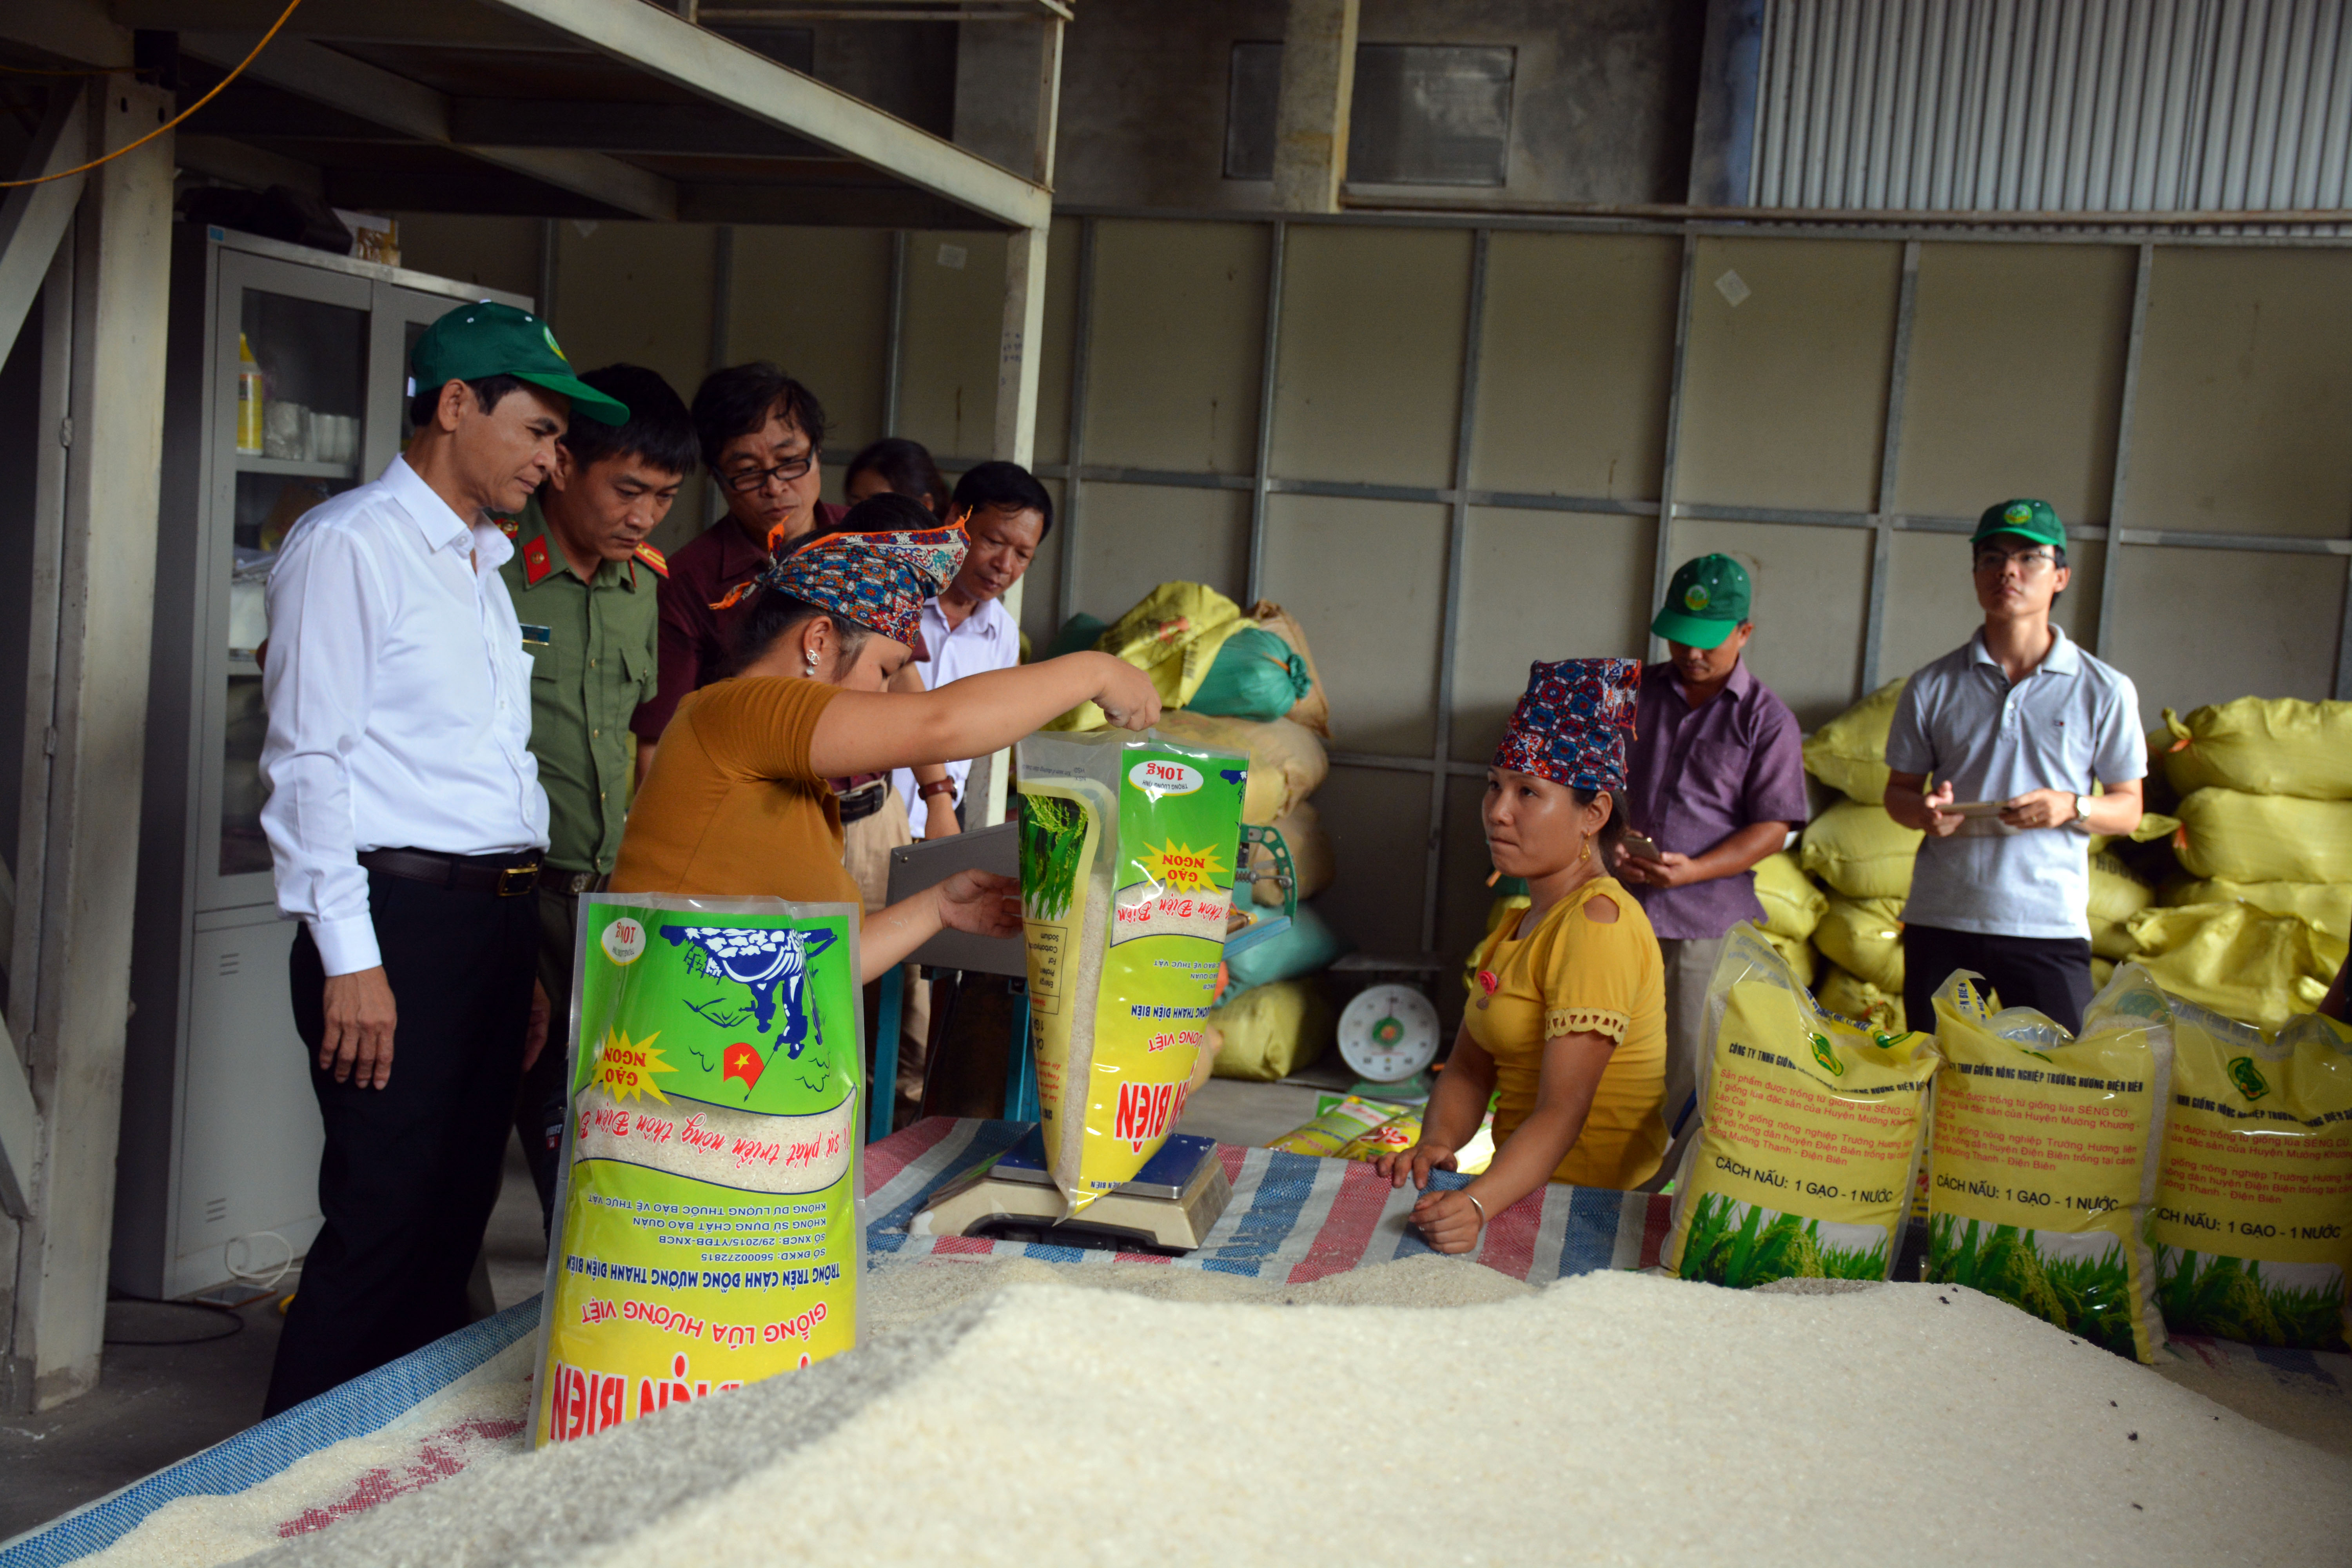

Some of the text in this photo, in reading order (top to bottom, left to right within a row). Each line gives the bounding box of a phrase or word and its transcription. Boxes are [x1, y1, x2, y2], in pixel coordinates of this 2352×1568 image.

[1146, 763, 1184, 781] 10kg
[1162, 854, 1205, 869] NGON
[1167, 867, 1198, 882] GẠO
[1159, 893, 1193, 918] Điện
[1198, 902, 1223, 921] thôn
[615, 922, 636, 944] 10kg
[1040, 933, 1059, 942] Sodium
[1040, 968, 1054, 976] Protein
[1039, 978, 1053, 988] Energy
[1131, 1005, 1194, 1020] THANH ĐIỆN BIÊN
[1148, 1033, 1175, 1053] VIỆT
[603, 1047, 646, 1067] NGON
[1748, 1048, 1756, 1058] TY
[1758, 1051, 1775, 1064] TNHH
[605, 1066, 638, 1086] GẠO
[1720, 1069, 1736, 1080] Sản
[1738, 1074, 1762, 1087] phẩm
[1765, 1082, 1787, 1094] được
[1858, 1103, 1871, 1112] lúa
[1725, 1083, 1748, 1097] giống
[1750, 1089, 1764, 1100] lúa
[1766, 1094, 1783, 1105] đặc
[1785, 1098, 1801, 1109] sản
[1804, 1104, 1821, 1114] của
[1825, 1107, 1855, 1120] Huyện
[1858, 1114, 1888, 1127] Mường
[1732, 1096, 1746, 1107] Cai
[2028, 1100, 2074, 1113] giống lúa
[1115, 1083, 1173, 1153] BIÊN
[1713, 1103, 1874, 1148] Công ty giống nông nghiệp Trường
[2025, 1111, 2058, 1123] Huyện
[2061, 1116, 2096, 1129] Mường
[595, 1105, 839, 1170] sự phát triển nông thôn Điện
[1739, 1123, 1861, 1155] nông dân huyện Điện Biên
[2183, 1124, 2207, 1136] được
[1729, 1131, 1847, 1165] Mường Thanh Điện Biên
[1983, 1131, 2119, 1154] nông nghiệp Trường Hương
[1990, 1143, 2070, 1160] huyện Điện Biên
[1973, 1151, 2056, 1171] Thanh Điện Biên
[1716, 1156, 1893, 1203] CÁCH NẤU: 1 GẠO 1 NƯỚC
[2202, 1163, 2267, 1181] nông nghiệp
[1937, 1173, 2118, 1211] CÁCH NẤU: 1 GẠO 1 NƯỚC
[2189, 1183, 2281, 1204] Thanh Điện Biên
[2244, 1180, 2269, 1192] Điện
[2272, 1184, 2296, 1193] Biên
[588, 1193, 826, 1218] KHÔNG DƯ LƯỢNG THUỐC BẢO VỆ THỰC VẬT
[633, 1217, 826, 1234] KHÔNG SỬ DỤNG CHẤT BẢO QUẢN
[2184, 1212, 2341, 1240] NẤU: 1 GẠO 1 NƯỚC
[659, 1233, 826, 1247] SỐ XNCB: 29/2015/YTĐB-XNCB
[701, 1249, 826, 1262] SỐ ĐKKD: 56000272815
[566, 1254, 840, 1293] TRỒNG TRÊN CÁNH ĐỒNG MƯỜNG THANH ĐIỆN BIÊN
[582, 1298, 827, 1350] GIỐNG LÚA HƯƠNG VIỆT
